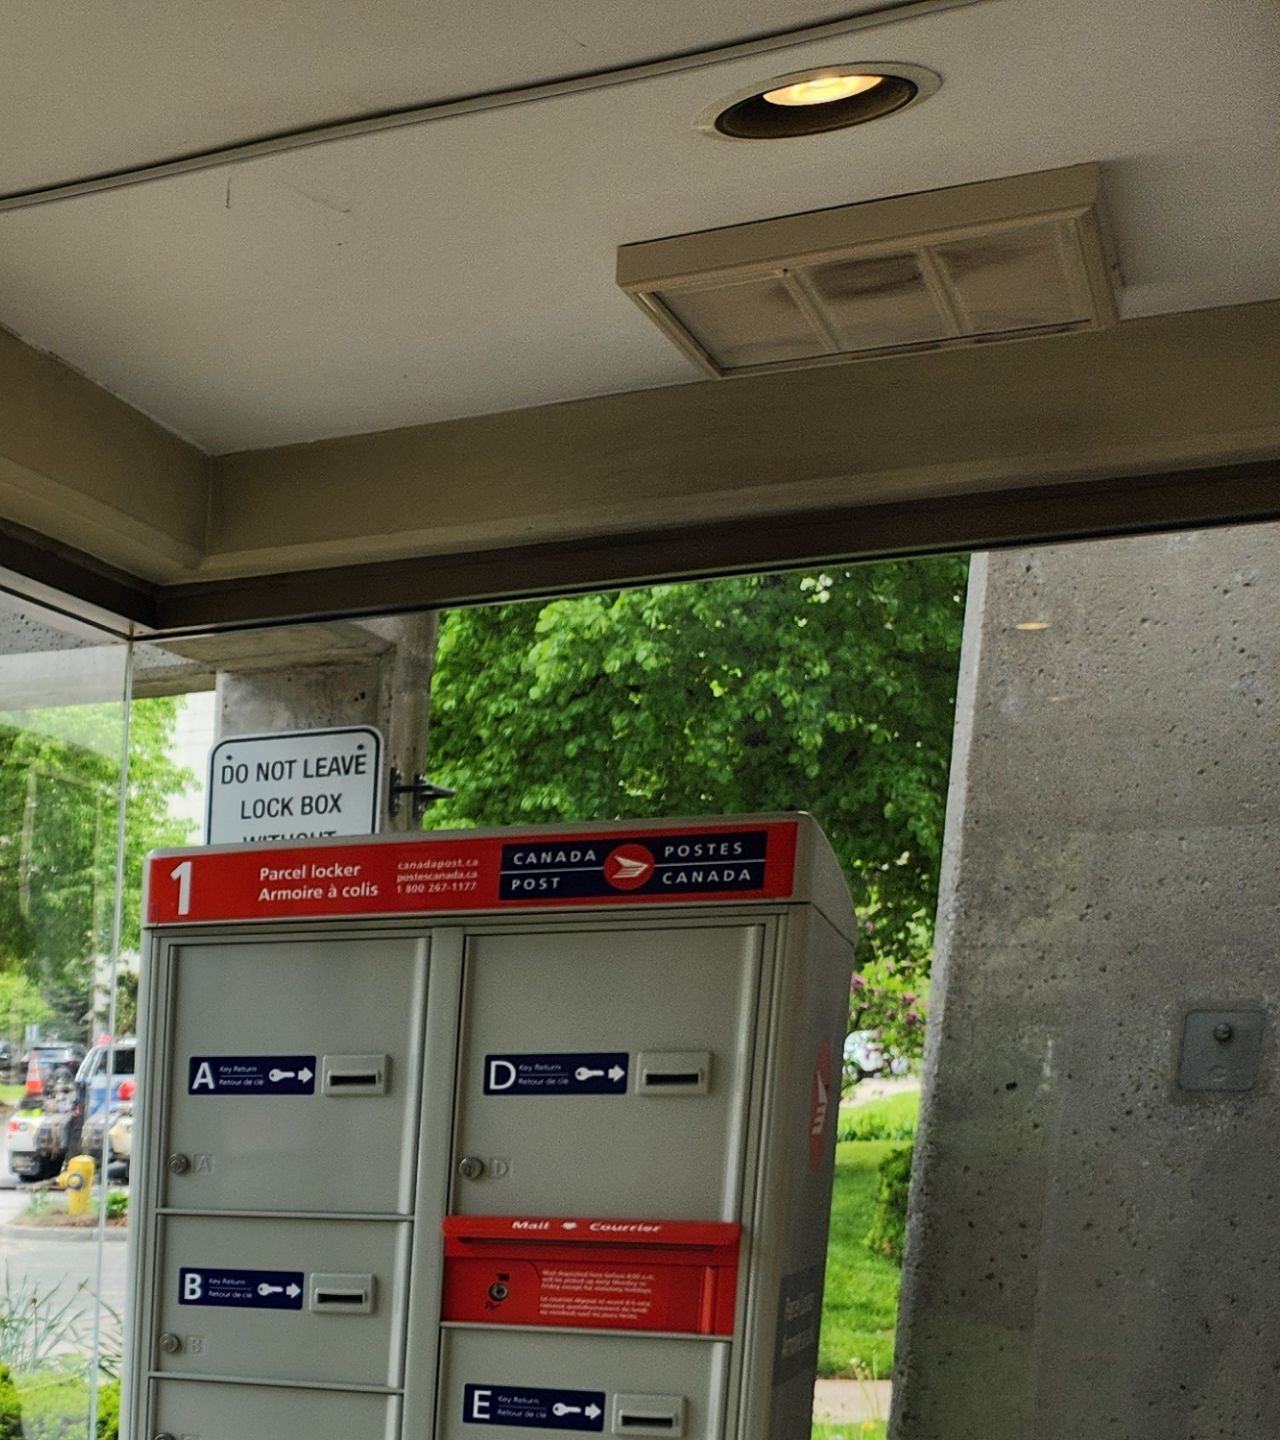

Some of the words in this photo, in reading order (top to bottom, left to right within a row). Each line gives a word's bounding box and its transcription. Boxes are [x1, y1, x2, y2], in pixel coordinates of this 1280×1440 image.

[221, 763, 249, 785] DO
[256, 759, 297, 782] NOT
[303, 753, 367, 779] LEAVE
[241, 797, 294, 820] LOCK
[301, 793, 342, 816] BOX
[513, 850, 597, 865] CANADA
[664, 842, 743, 858] POSTES
[260, 864, 306, 881] Parcel
[311, 862, 361, 879] locker
[397, 858, 479, 870] canadapost.ca
[511, 877, 561, 891] POST
[662, 869, 751, 885] CANADA
[170, 861, 192, 916] 1
[258, 886, 323, 902] Armoire
[328, 883, 337, 898] à
[342, 882, 379, 898] colis
[397, 884, 402, 894] 1
[405, 883, 425, 894] 800
[192, 1062, 215, 1089] A
[489, 1060, 516, 1090] D
[512, 1221, 550, 1230] Mail
[590, 1222, 662, 1232] Courrier
[184, 1273, 202, 1300] B
[473, 1390, 491, 1419] E
